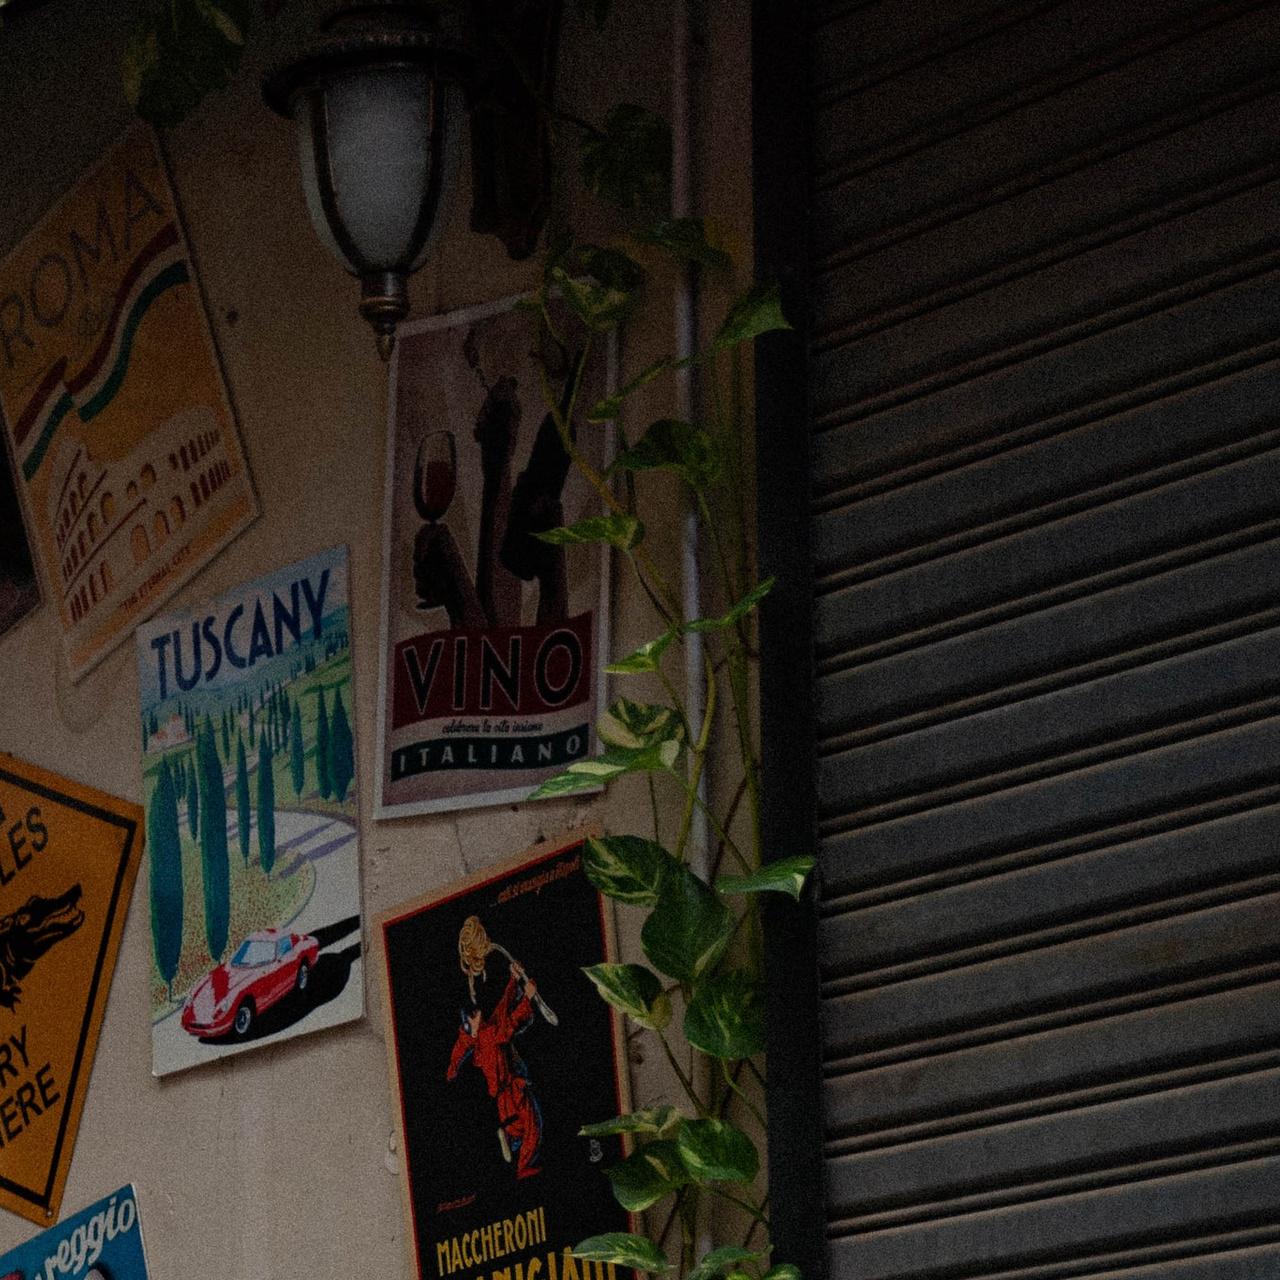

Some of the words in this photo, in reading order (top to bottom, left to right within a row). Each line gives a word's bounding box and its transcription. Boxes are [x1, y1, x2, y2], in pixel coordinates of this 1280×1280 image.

[152, 569, 330, 700] TUSCANY
[402, 628, 583, 716] VINO
[399, 734, 581, 773] ITALIANO
[436, 1206, 548, 1278] MACCHERONI
